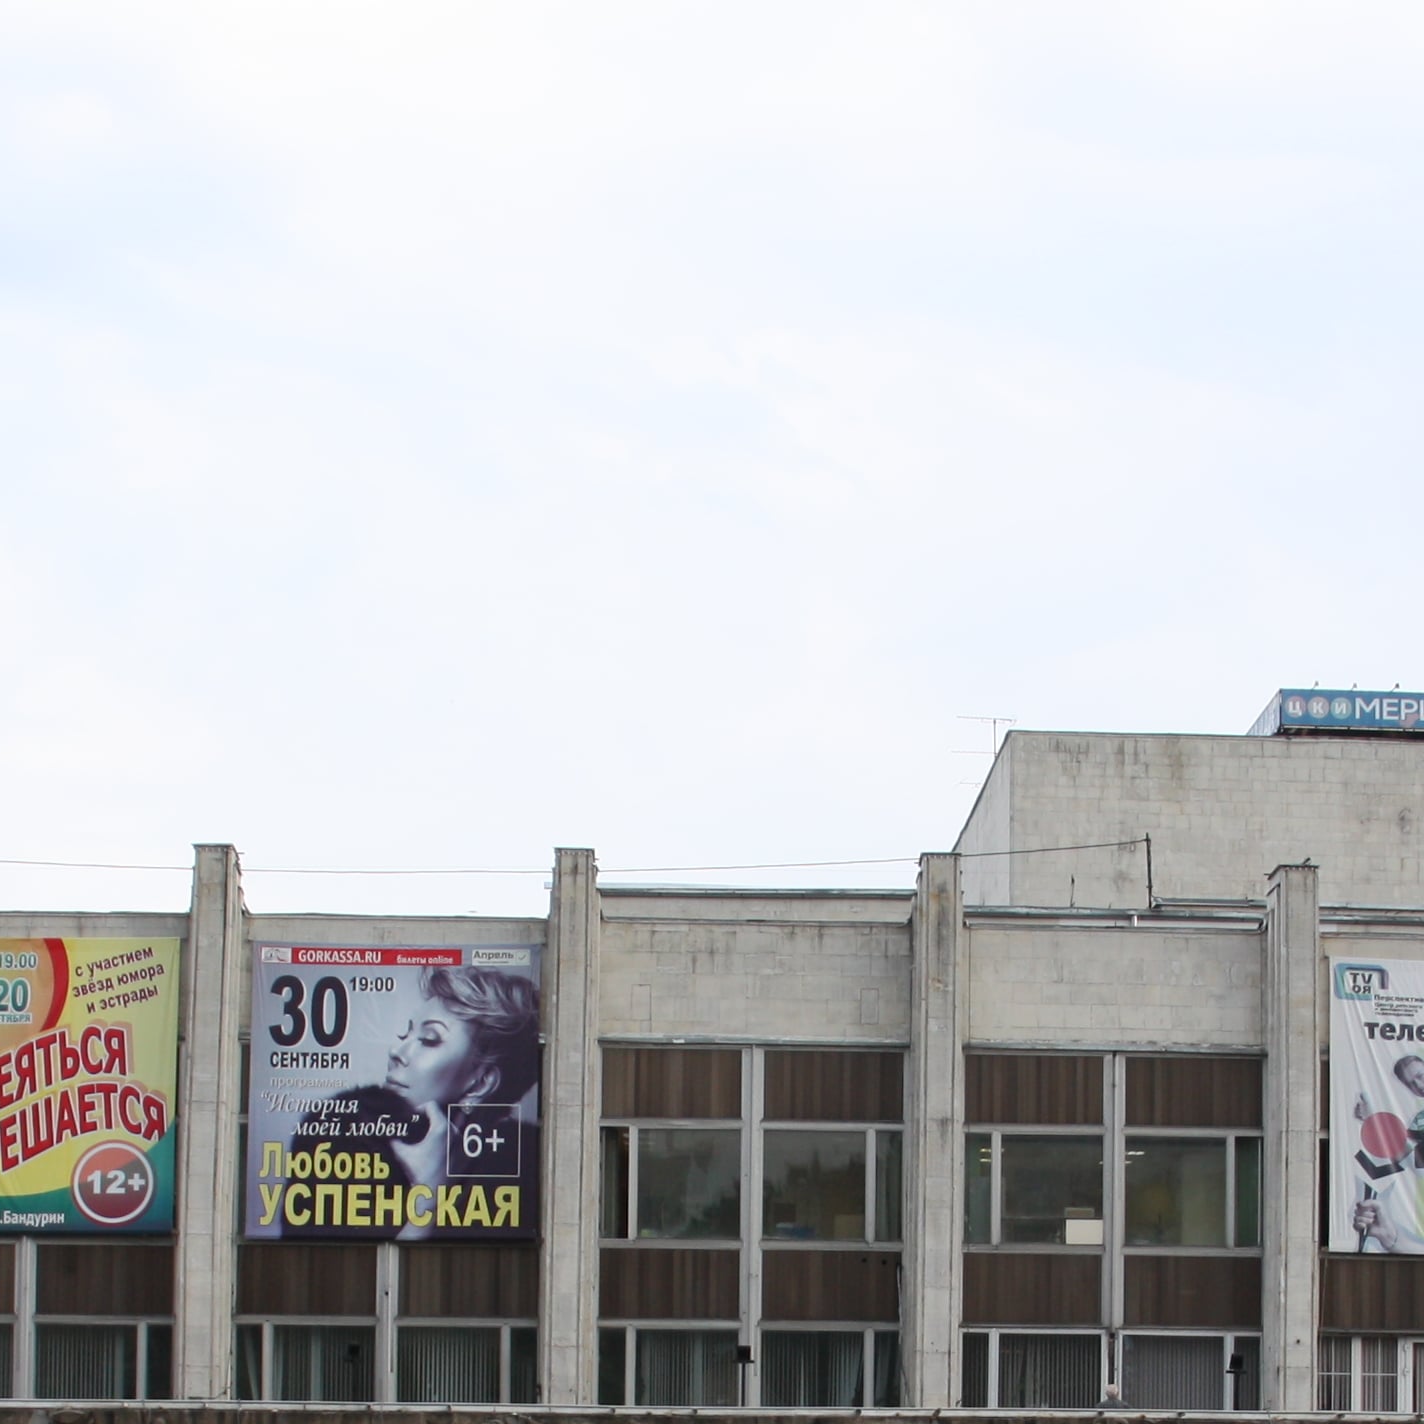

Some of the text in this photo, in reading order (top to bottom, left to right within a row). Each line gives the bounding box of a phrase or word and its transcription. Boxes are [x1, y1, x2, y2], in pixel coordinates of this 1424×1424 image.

[75, 947, 154, 977] с участием
[298, 950, 381, 963] GORKASSA.RU
[72, 963, 164, 997] звёзд юмора
[349, 976, 395, 991] 19:00
[87, 985, 158, 1014] и эстрады
[268, 974, 348, 1047] 30
[270, 1052, 349, 1069] СЕНТЯБРЯ
[291, 1117, 341, 1136] моей
[462, 1123, 505, 1158] 6+
[259, 1141, 390, 1179] Любовь
[86, 1170, 145, 1195] 12+
[258, 1183, 520, 1227] УСПЕНСКАЯ
